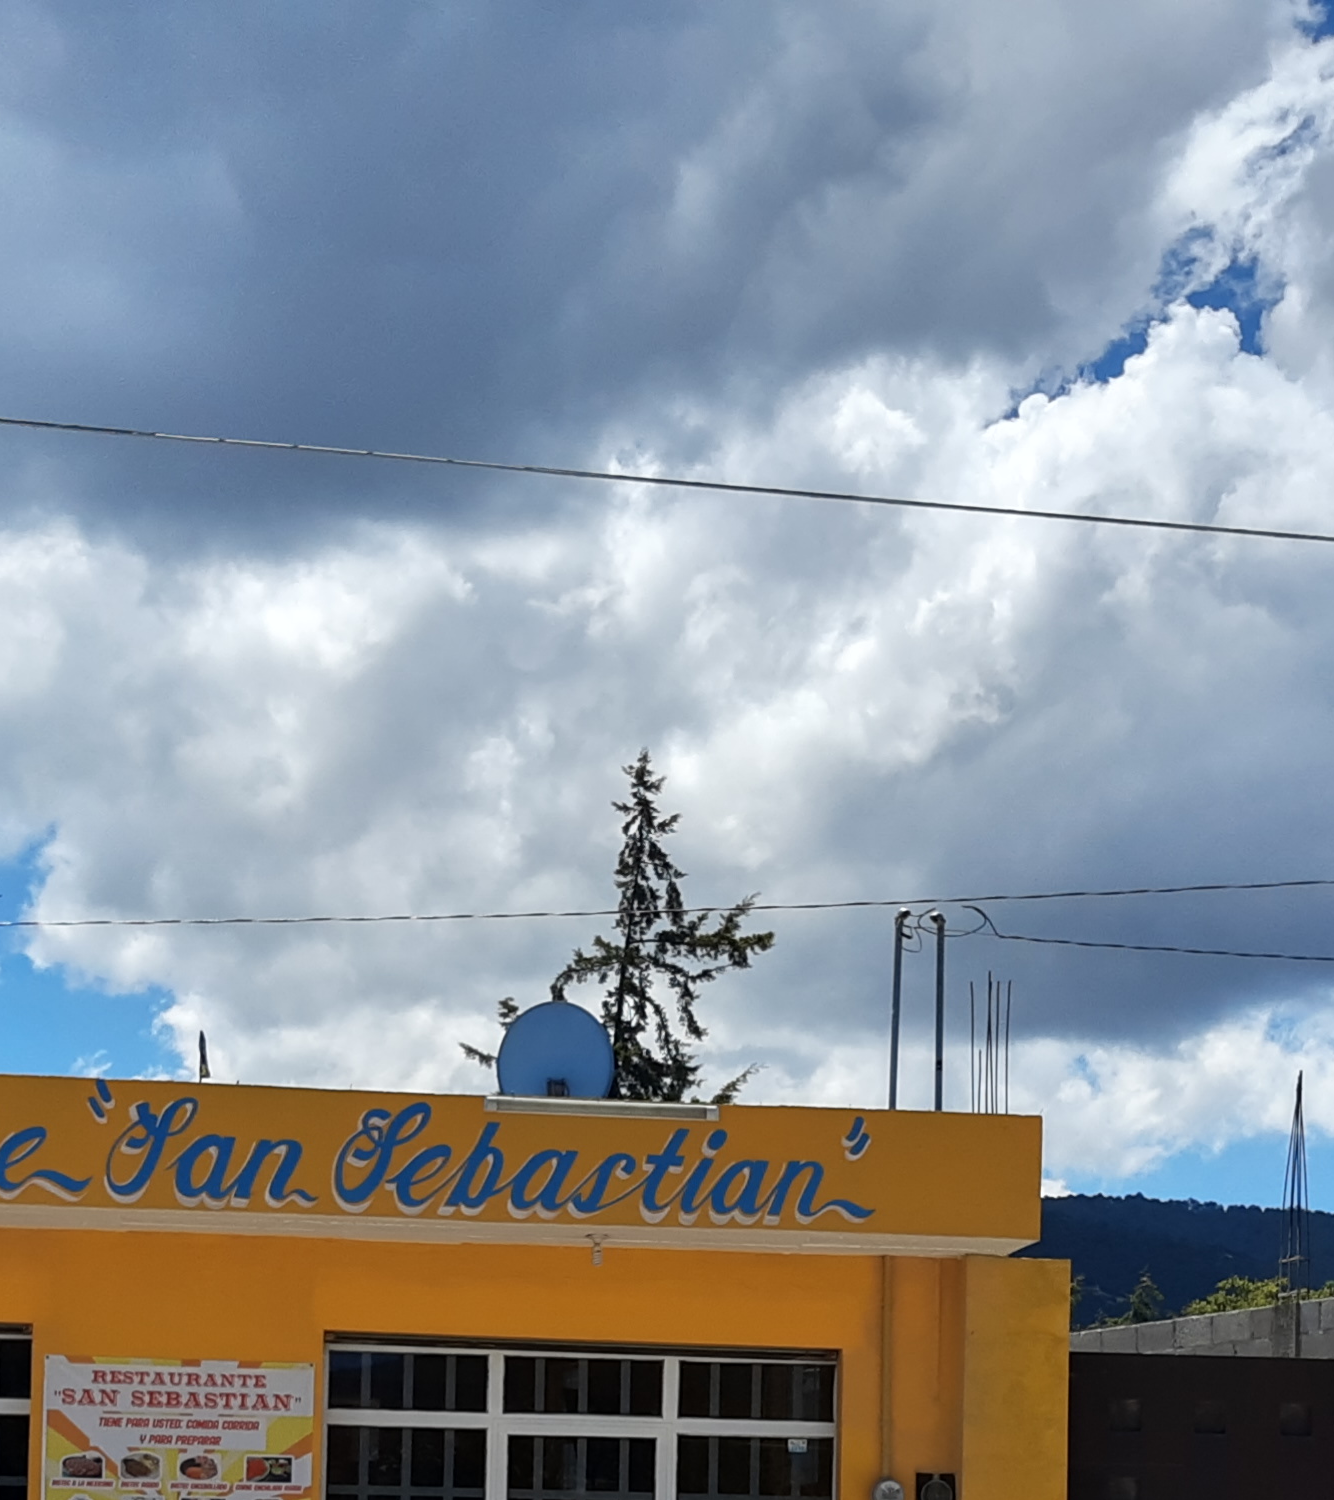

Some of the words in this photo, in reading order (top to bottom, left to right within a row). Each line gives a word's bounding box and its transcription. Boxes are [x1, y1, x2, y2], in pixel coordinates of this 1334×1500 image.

[91, 1369, 268, 1388] RESTAURANTE
[54, 1388, 119, 1408] "SAN
[130, 1389, 302, 1412] SEBASTIAN"
[98, 1416, 123, 1428] TIENE
[124, 1417, 150, 1428] PARA
[185, 1419, 219, 1430] COMIDA
[221, 1420, 260, 1431] CORRIDA
[139, 1434, 147, 1444] Y
[148, 1434, 173, 1445] PARA
[174, 1435, 222, 1446] PREPARAR
